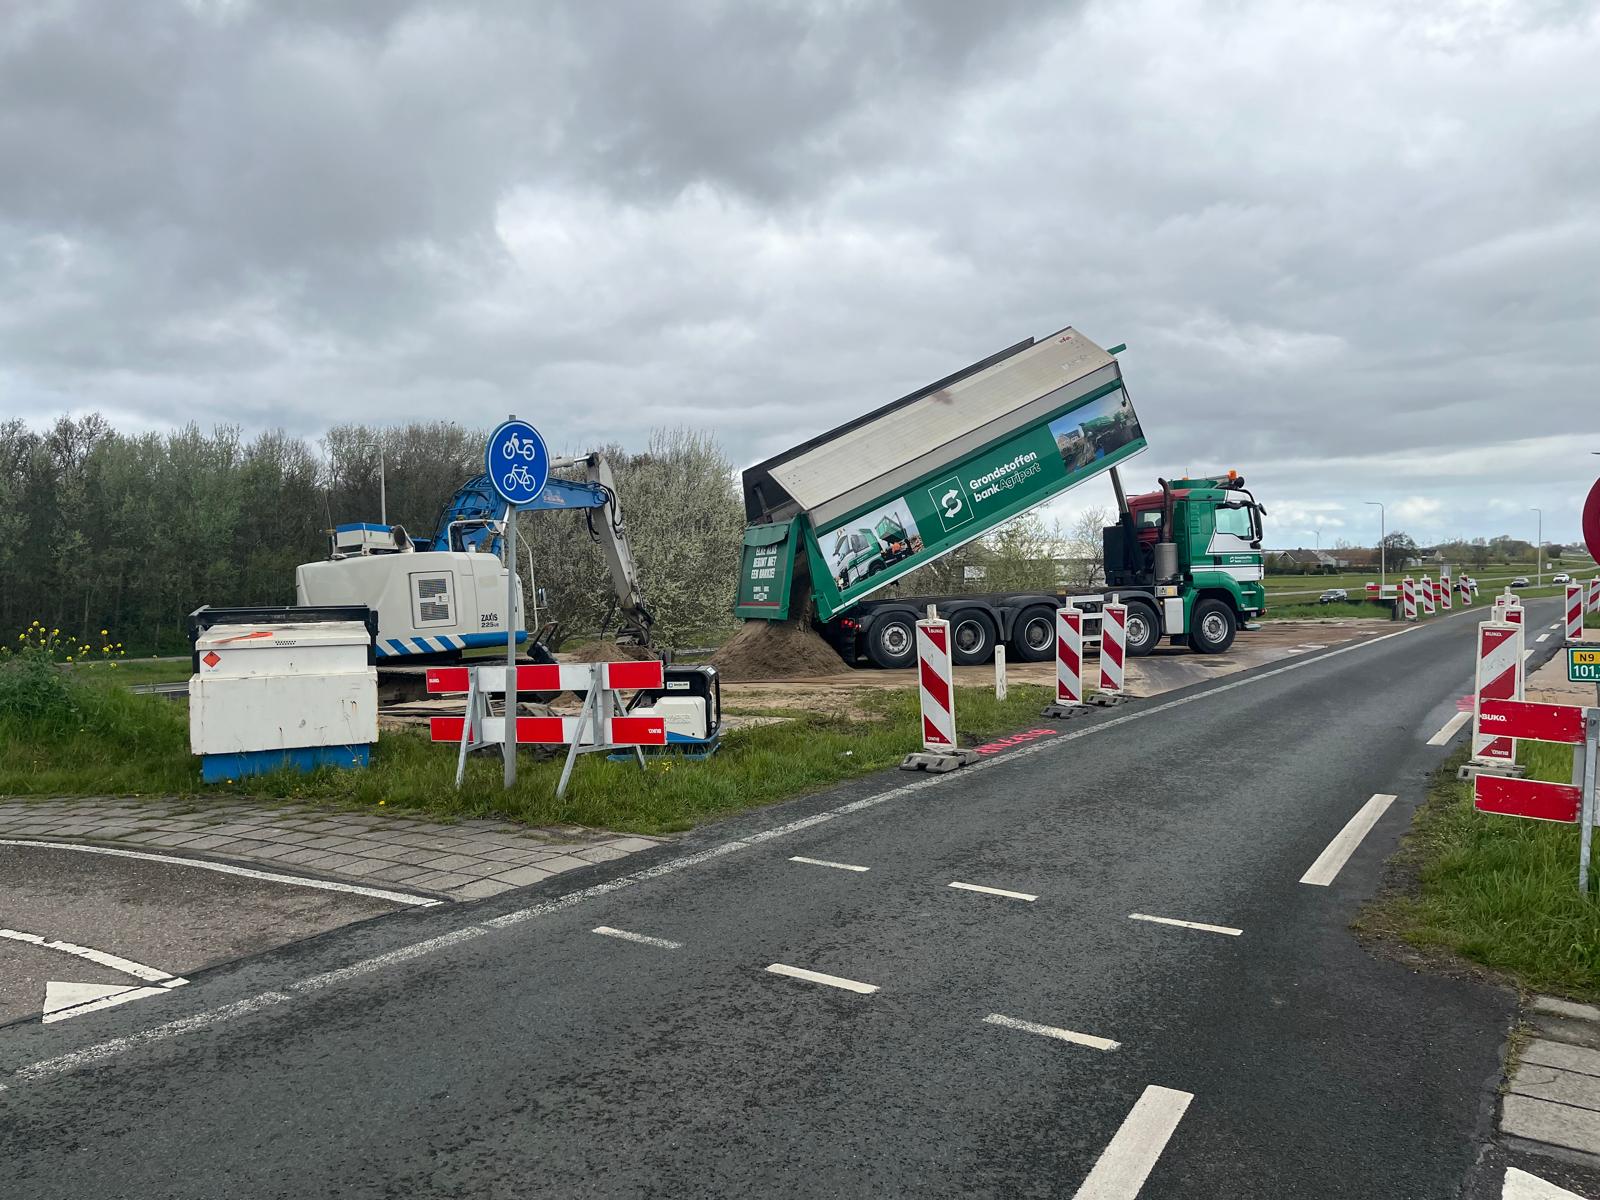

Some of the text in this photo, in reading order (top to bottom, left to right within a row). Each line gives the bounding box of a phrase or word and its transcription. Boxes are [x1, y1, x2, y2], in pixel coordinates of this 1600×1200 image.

[969, 451, 1038, 490] Grondstoffen
[481, 612, 498, 621] ZAXIS
[1574, 665, 1600, 678] 101,
